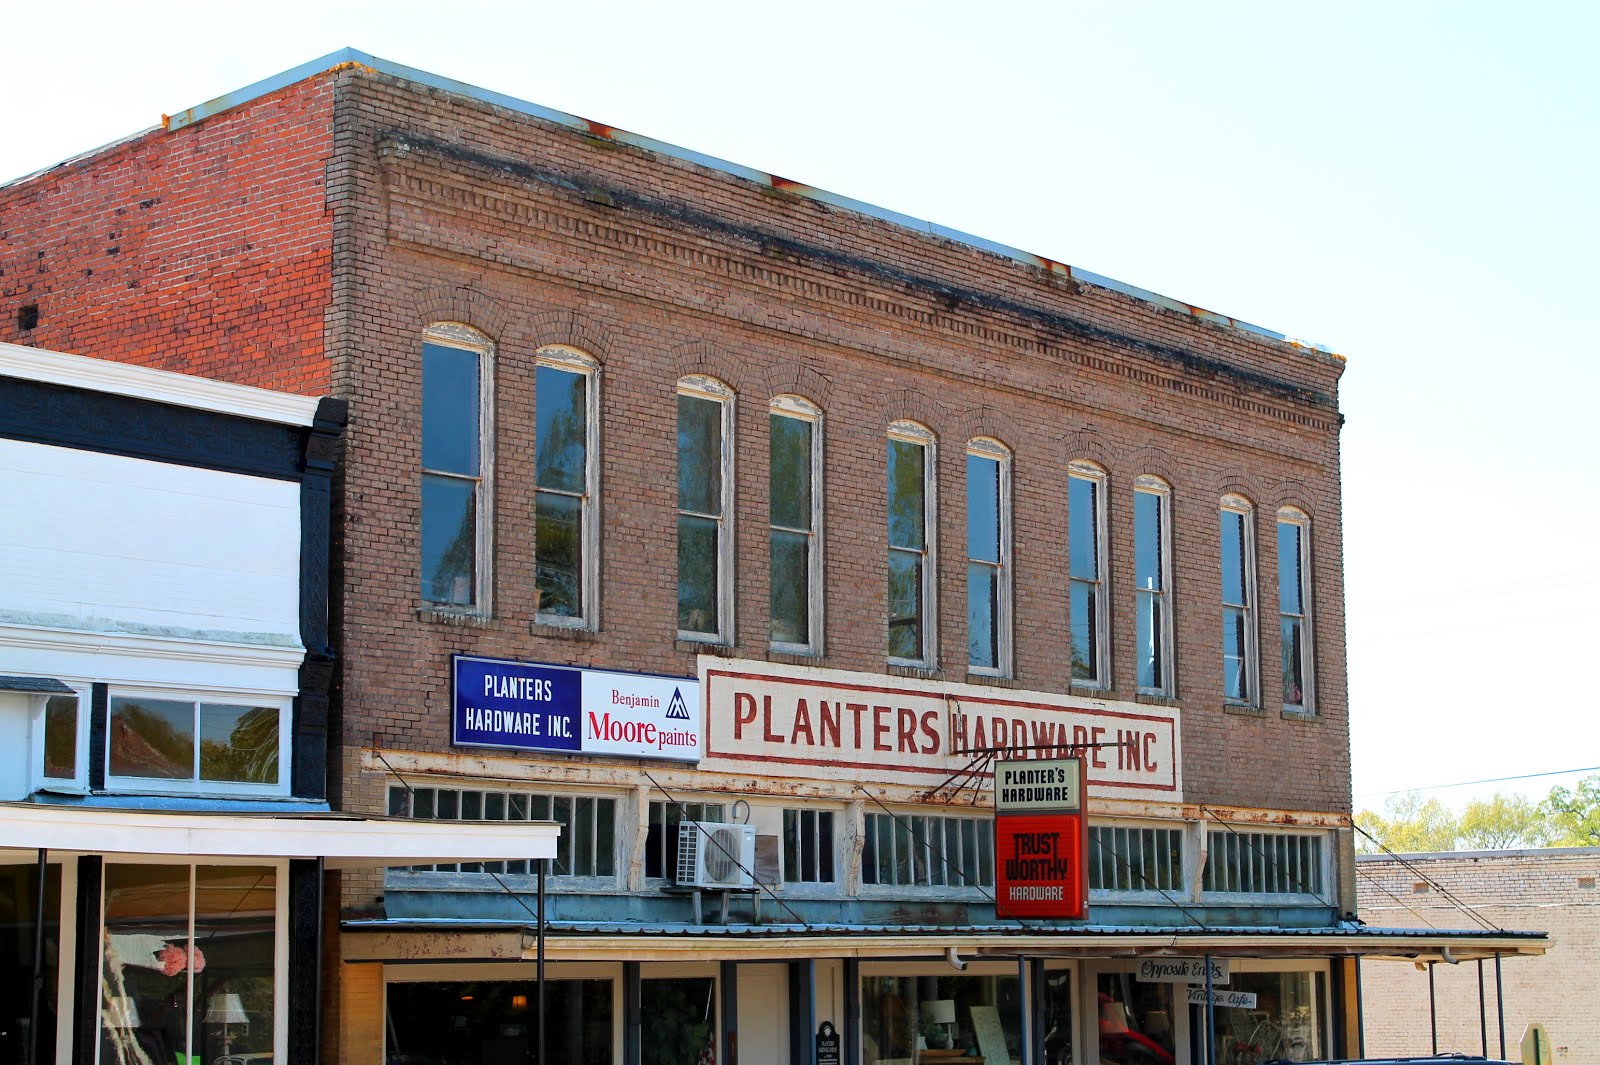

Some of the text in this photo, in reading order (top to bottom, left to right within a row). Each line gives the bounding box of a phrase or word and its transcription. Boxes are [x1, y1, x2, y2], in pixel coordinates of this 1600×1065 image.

[484, 674, 552, 701] PLANTERS
[612, 689, 660, 709] Benjamin
[465, 707, 573, 738] HARDWARE INC.
[588, 711, 697, 750] Moore paints
[734, 692, 1158, 773] PLANTERS HARDWARE INC
[1004, 767, 1065, 785] PLANTER'S
[1002, 787, 1068, 803] HARDWARE
[1012, 832, 1060, 857] TRUST
[1005, 857, 1068, 881] WORTHY
[1009, 886, 1064, 901] HARDWARE
[1141, 960, 1190, 979] Opposite
[1185, 988, 1253, 1007] Vintge Cafe
